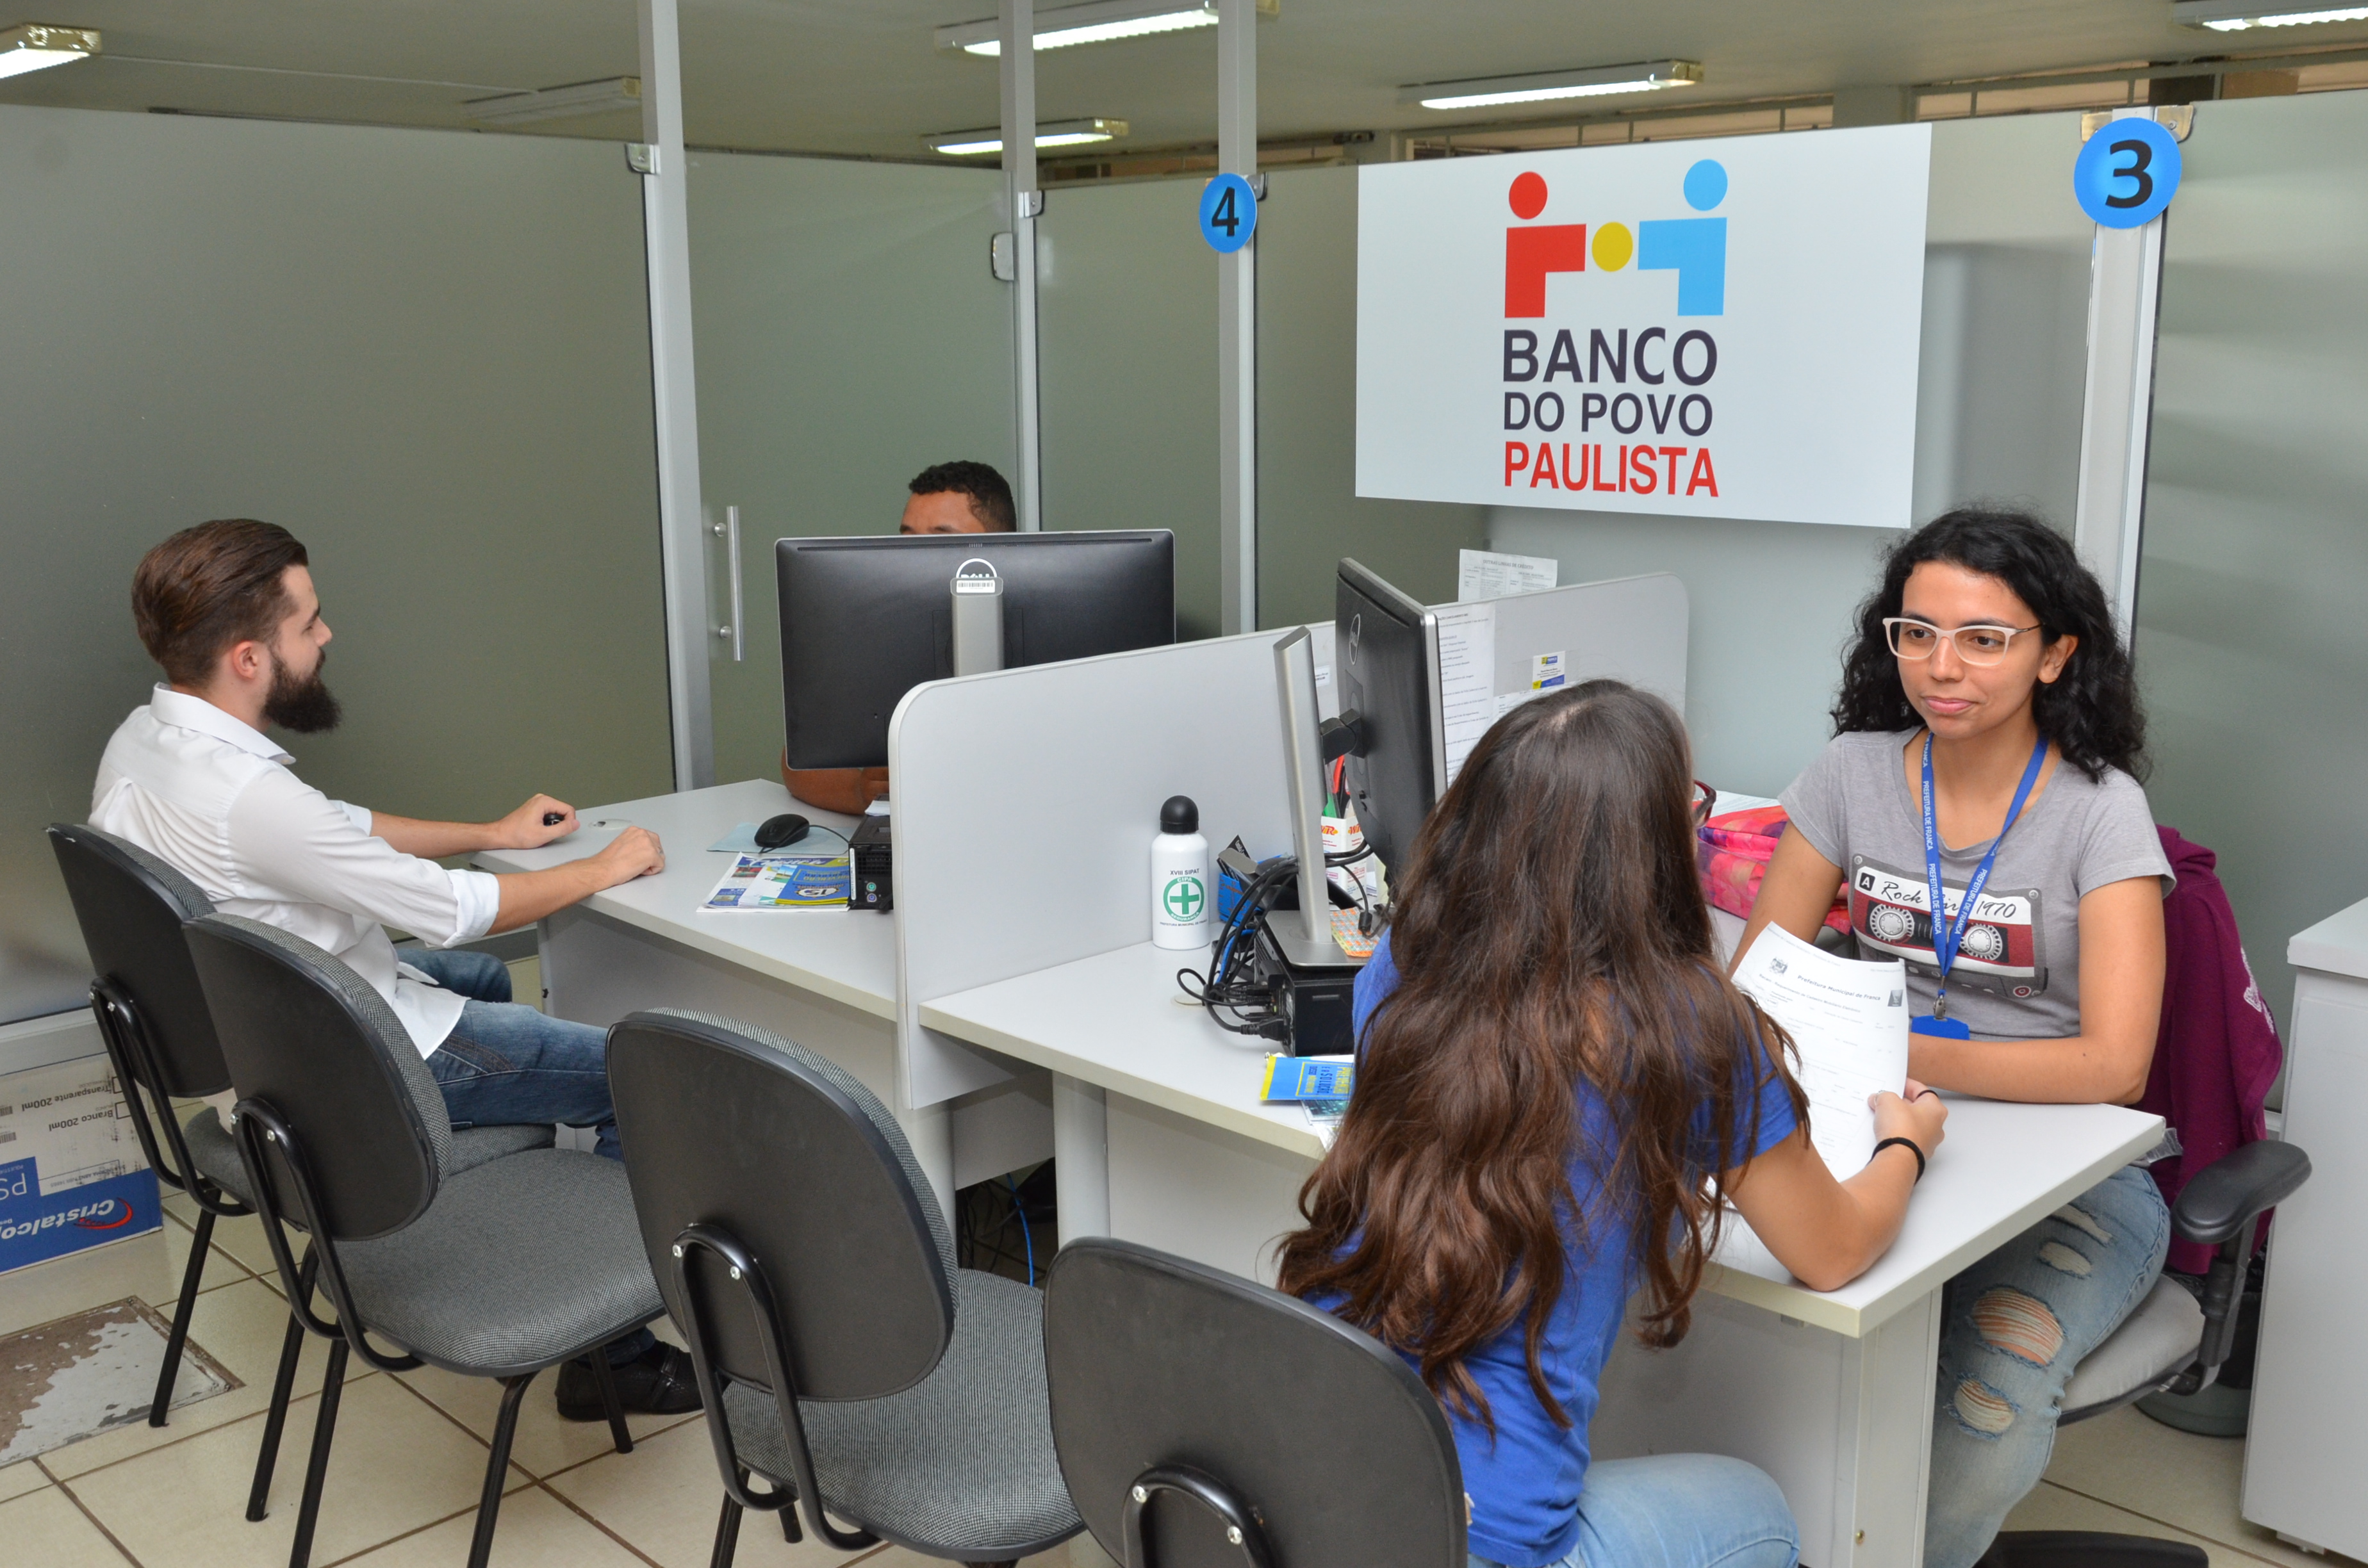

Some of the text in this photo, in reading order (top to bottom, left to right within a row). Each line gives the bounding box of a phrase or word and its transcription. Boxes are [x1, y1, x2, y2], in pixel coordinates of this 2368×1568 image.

[2105, 139, 2153, 209] 3
[1211, 186, 1239, 237] 4
[1502, 327, 1718, 386] BANCO
[1504, 392, 1713, 437] DO POVO
[1504, 441, 1719, 497] PAULISTA
[1925, 817, 1931, 825] DE
[1925, 826, 1933, 851] FRANCA
[1171, 911, 1200, 921] SEGURANÇA
[1861, 876, 1871, 888] A
[1881, 881, 1923, 904] Rock
[1976, 900, 2016, 918] 1970
[1928, 863, 1942, 935] PREFEITURA DE FRANCA
[1954, 869, 1987, 935] PREFEITURA DE FRANCA
[1798, 975, 1827, 989] Prefeitura
[1827, 986, 1855, 997] Municipal
[22, 1085, 112, 1112] Transparente 200ml
[49, 1109, 113, 1132] Branco 200ml
[0, 1199, 115, 1239] Cristalco
